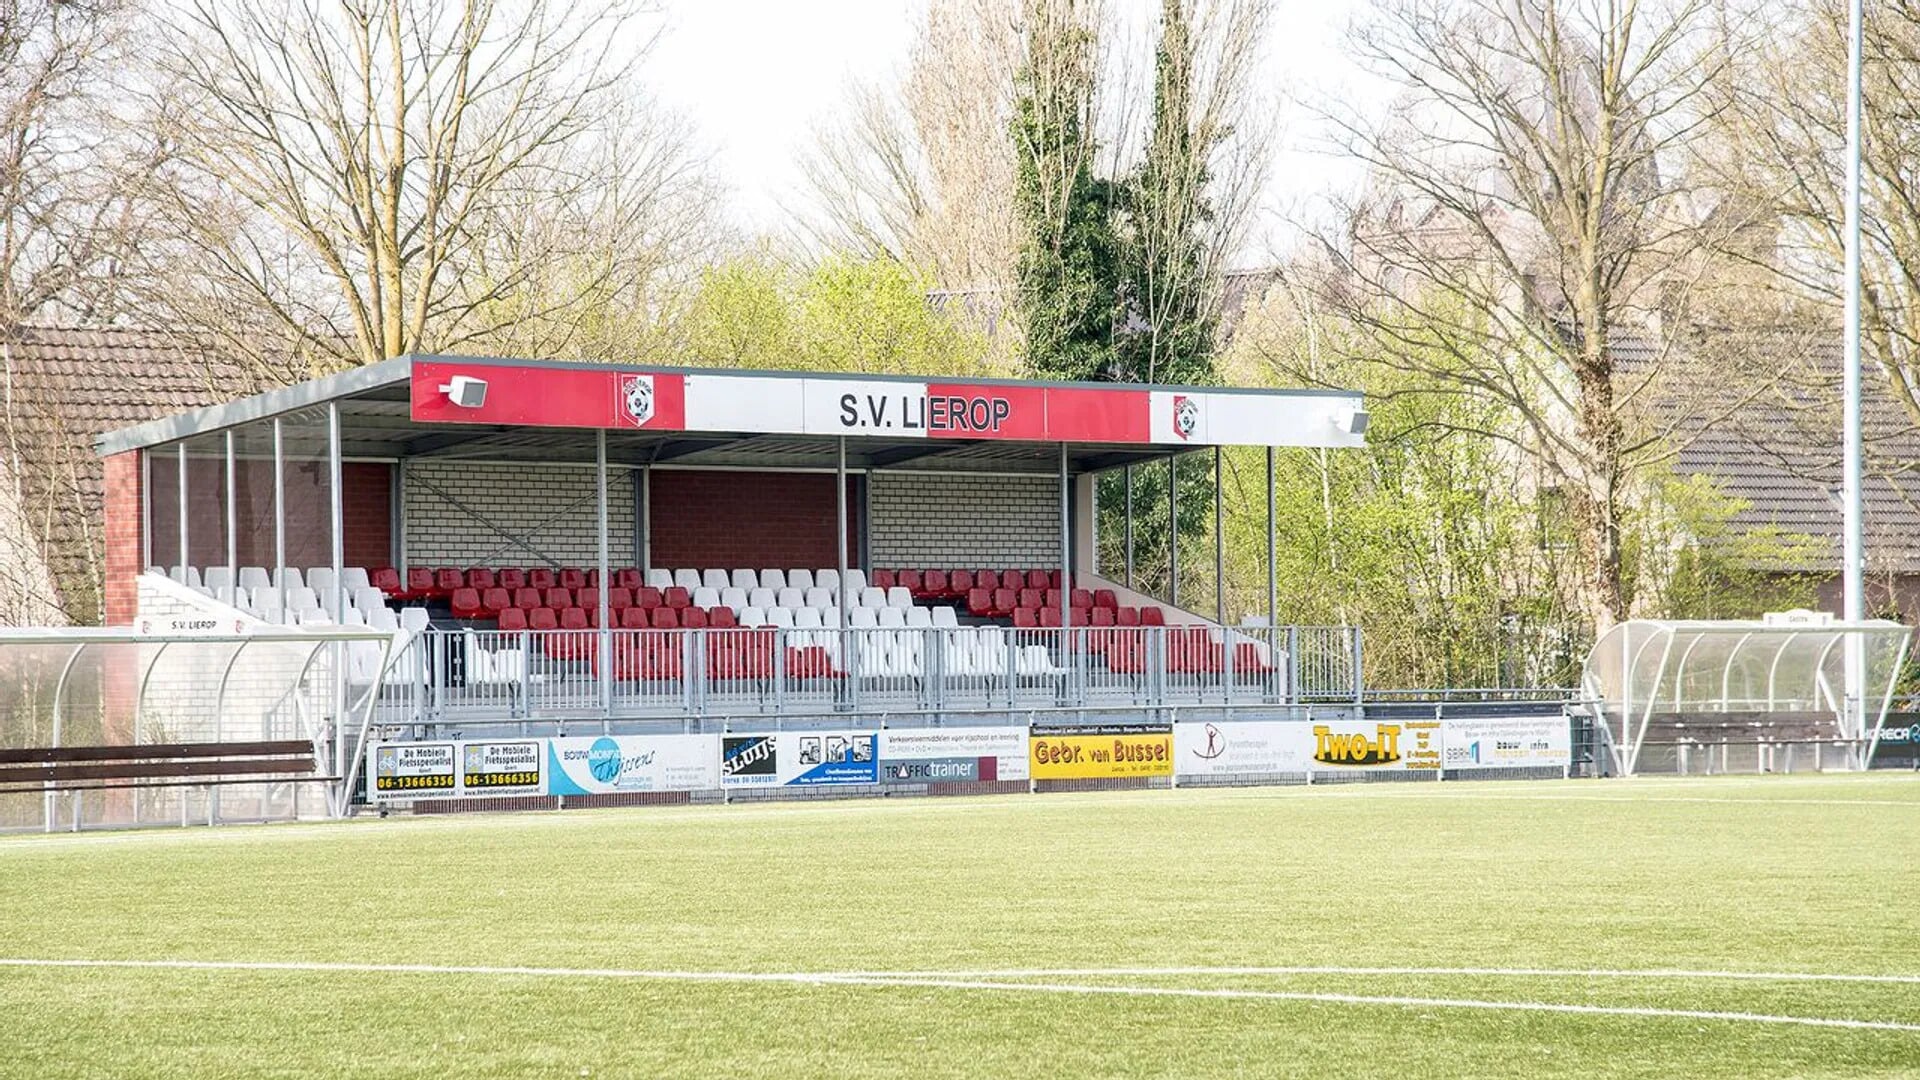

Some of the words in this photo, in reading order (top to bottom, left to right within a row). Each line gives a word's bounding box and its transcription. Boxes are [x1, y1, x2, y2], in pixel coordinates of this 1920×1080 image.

[840, 394, 892, 428] S.V.
[902, 395, 1010, 432] LIEROP
[172, 621, 186, 630] S.V.
[189, 621, 217, 630] LIEROP
[404, 749, 414, 758] De
[416, 748, 447, 758] Mobiele
[490, 747, 500, 755] De
[502, 746, 531, 755] Mobiele
[722, 736, 777, 777] SLUIJS
[1034, 740, 1085, 765] Gebr.
[1089, 750, 1110, 763] van
[1113, 738, 1170, 762] Bussel
[399, 758, 452, 768] Fietsspecialist
[485, 754, 536, 765] Fietsspecialist
[377, 775, 454, 789] 06-13666356
[464, 772, 539, 786] 06-13666356
